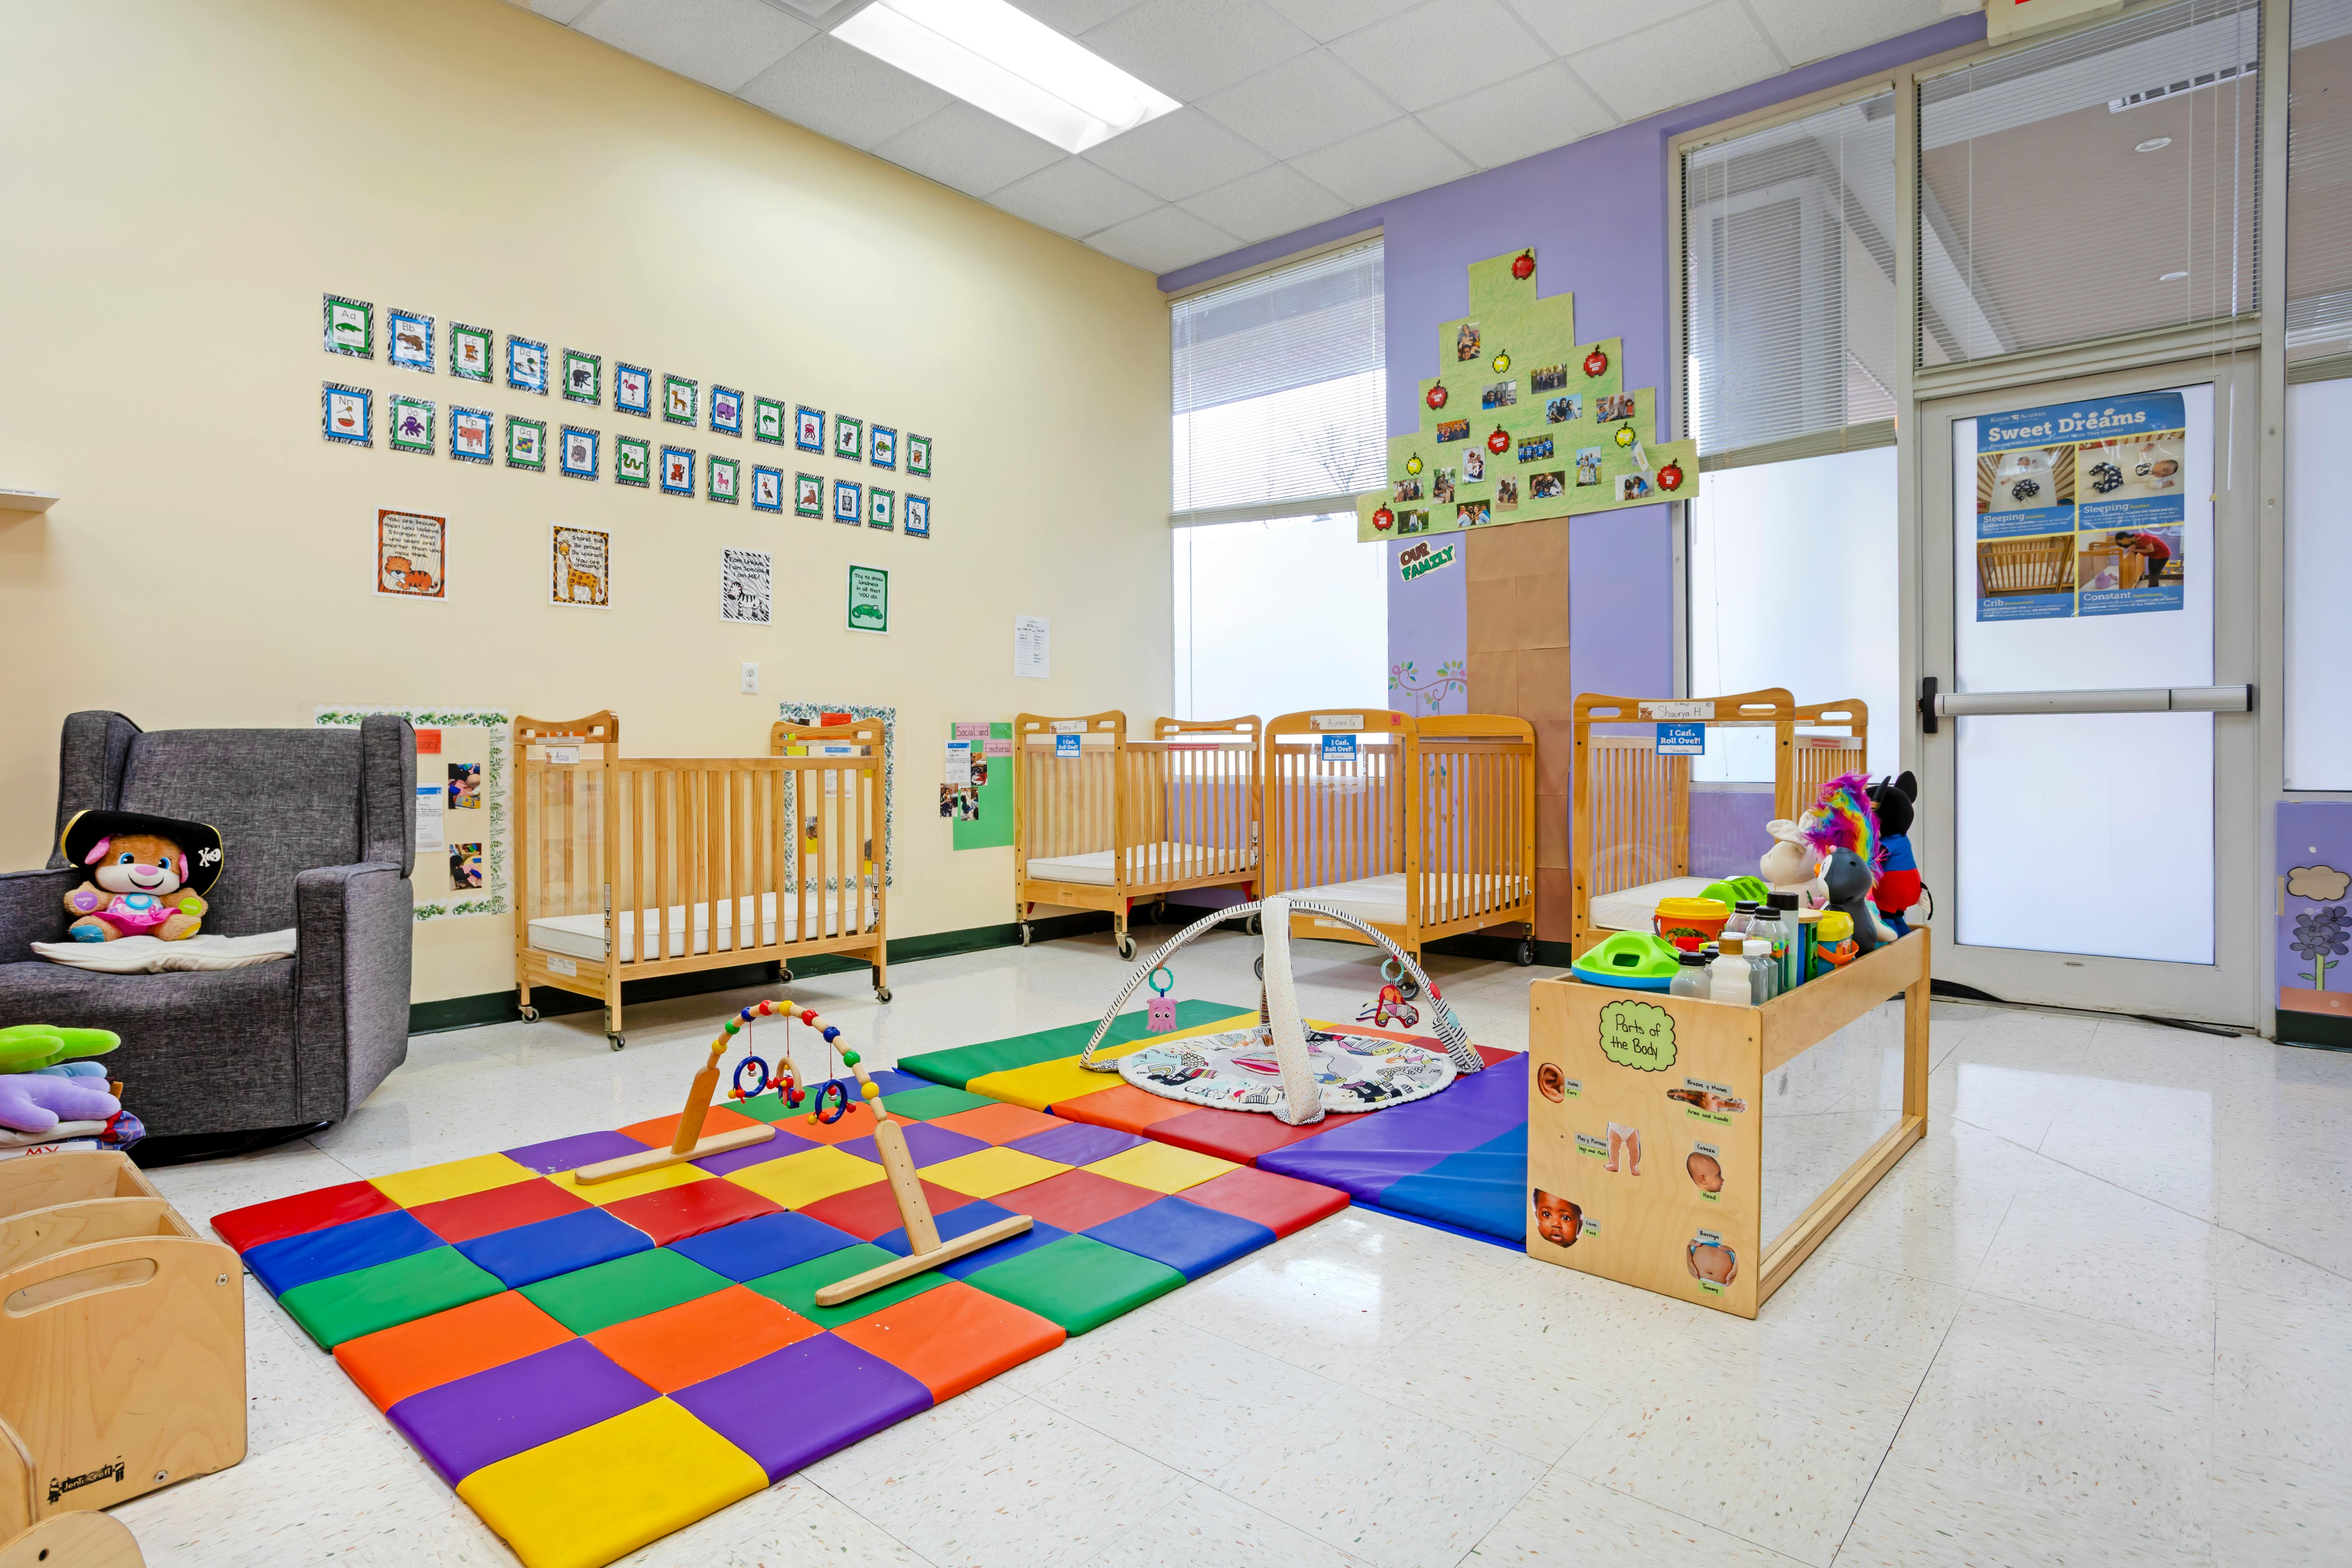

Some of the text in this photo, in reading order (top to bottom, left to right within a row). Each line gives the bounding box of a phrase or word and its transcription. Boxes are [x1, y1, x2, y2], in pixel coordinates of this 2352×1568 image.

[341, 310, 356, 320] Aa
[402, 322, 415, 332] Bb
[337, 335, 363, 345] Alligator
[465, 335, 476, 345] Cc
[520, 347, 531, 357] Dd
[576, 361, 587, 371] Ee
[628, 373, 637, 382] Ff
[571, 385, 591, 394] Elephant
[675, 384, 685, 395] Gg
[339, 396, 353, 406] Nn
[622, 397, 643, 407] Flamingo
[722, 395, 730, 404] Hh
[407, 407, 418, 416] Oo
[466, 416, 477, 427] Pp
[807, 415, 812, 424] Jj
[336, 426, 357, 434] Noodle
[1989, 411, 2146, 442] Sweet Dreams
[520, 427, 532, 438] Qq
[400, 434, 424, 443] Octopus
[574, 436, 584, 445] Rr
[802, 437, 817, 446] Jellyfish
[718, 465, 727, 473] Uu
[879, 495, 885, 504] Yy
[2084, 504, 2129, 513] Sleeping
[1984, 514, 2025, 523] Sleeping
[1400, 542, 1430, 566] OUR
[1402, 546, 1453, 581] FAMILY
[2084, 592, 2131, 600] Constant
[1658, 706, 1690, 720] Shaurya
[1327, 718, 1347, 727] Aurora
[957, 726, 988, 736] Social and
[985, 743, 1011, 753] Emotional
[1615, 1014, 1661, 1037] Parts of
[1610, 1035, 1657, 1060] the Body
[1687, 1080, 1703, 1088] Brazos
[1697, 1144, 1715, 1153] Cabeza
[1700, 1231, 1719, 1240] Barriga
[1701, 1283, 1718, 1294] Tummy
